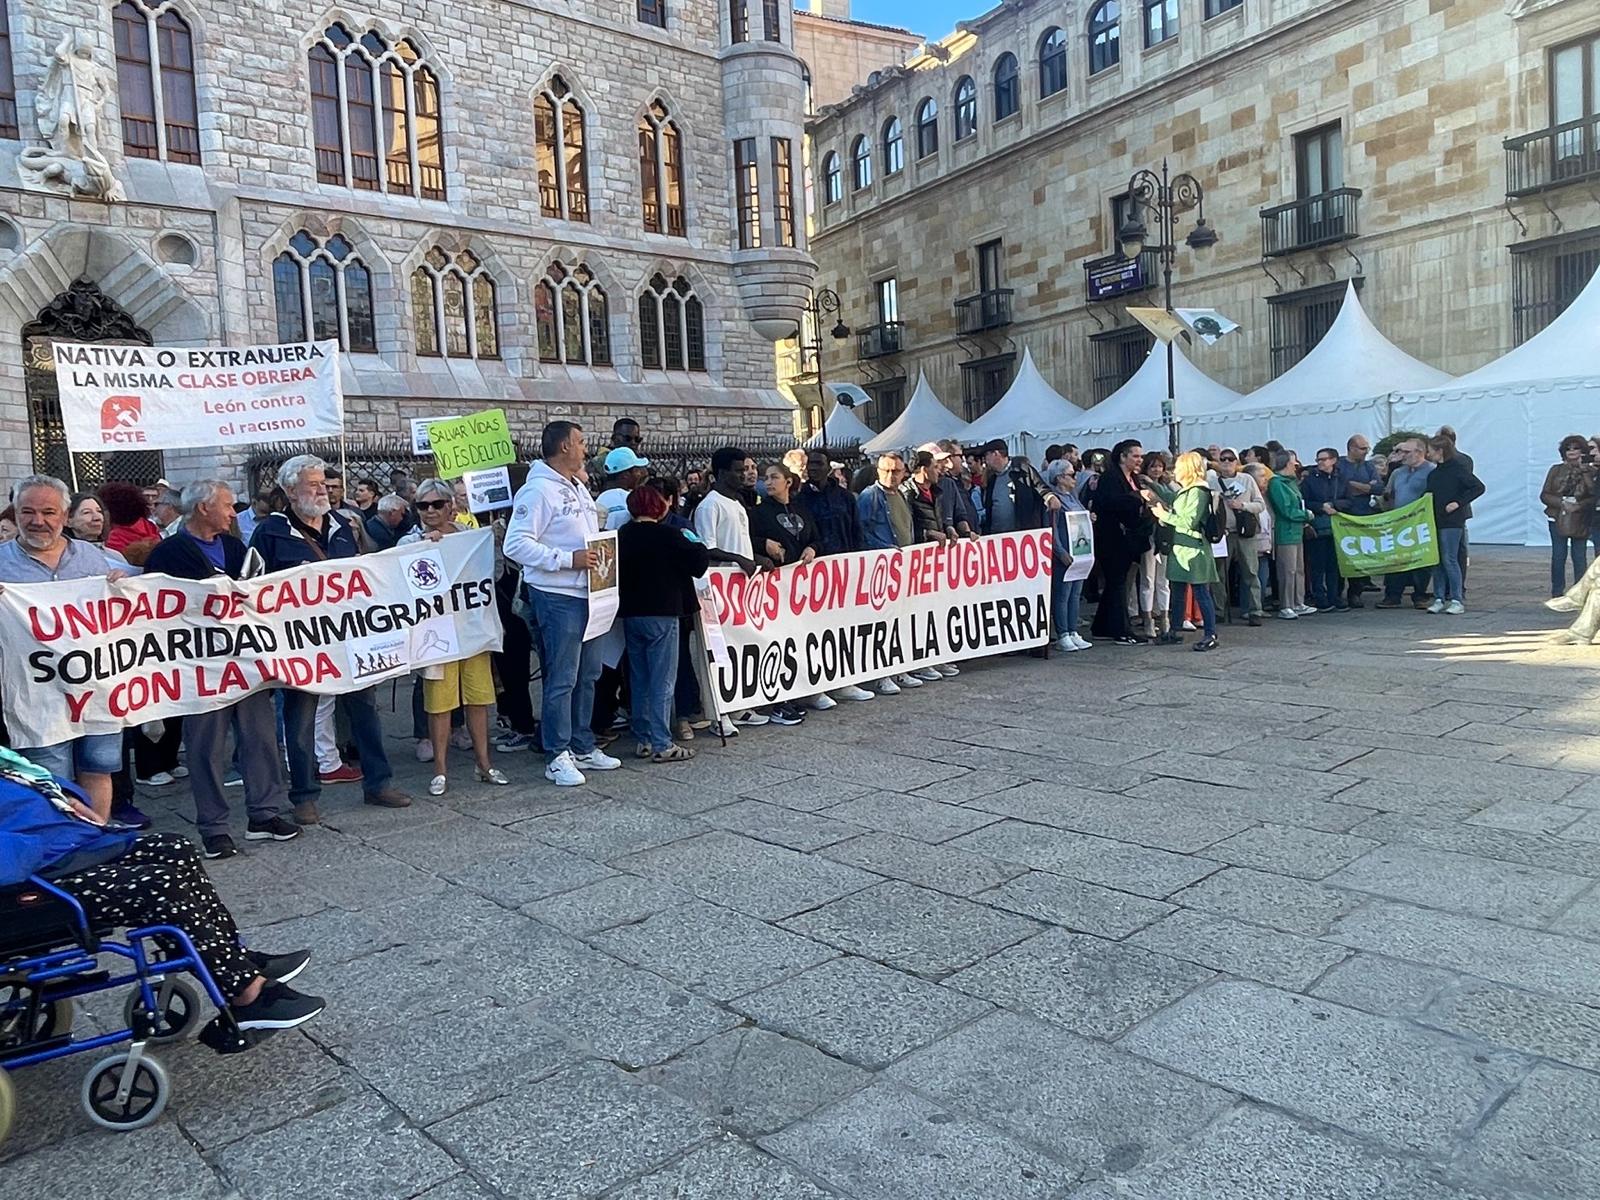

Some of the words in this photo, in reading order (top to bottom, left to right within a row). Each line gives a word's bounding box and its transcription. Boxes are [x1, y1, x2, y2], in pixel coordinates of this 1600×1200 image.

[57, 346, 145, 367] NATIVA
[157, 350, 176, 367] O
[188, 344, 324, 367] EXTRANJERA
[73, 372, 99, 388] LA
[104, 372, 173, 389] MISMA
[178, 373, 237, 389] CLASE
[242, 367, 317, 386] OBRERA
[204, 400, 246, 414] León
[250, 395, 305, 410] contra
[102, 431, 147, 444] PCTE
[219, 422, 234, 436] el
[239, 417, 305, 434] racismo
[430, 424, 468, 444] SALVAR
[467, 418, 500, 435] VIDAS
[434, 450, 452, 471] NO
[709, 566, 780, 631] OD@S
[789, 557, 850, 615] CON
[855, 550, 903, 611] L@S
[907, 531, 1053, 597] REFUGIADOS
[27, 588, 187, 642] UNIDAD
[203, 592, 249, 620] DE
[256, 569, 373, 614] CAUSA
[806, 616, 904, 687] CONTRA
[911, 610, 940, 660] LA
[946, 594, 1048, 653] GUERRA
[29, 624, 278, 684] SOLIDARIDAD
[64, 690, 94, 722] Y
[109, 666, 180, 718] CON
[195, 659, 249, 695] LA
[255, 651, 342, 686] VIDA
